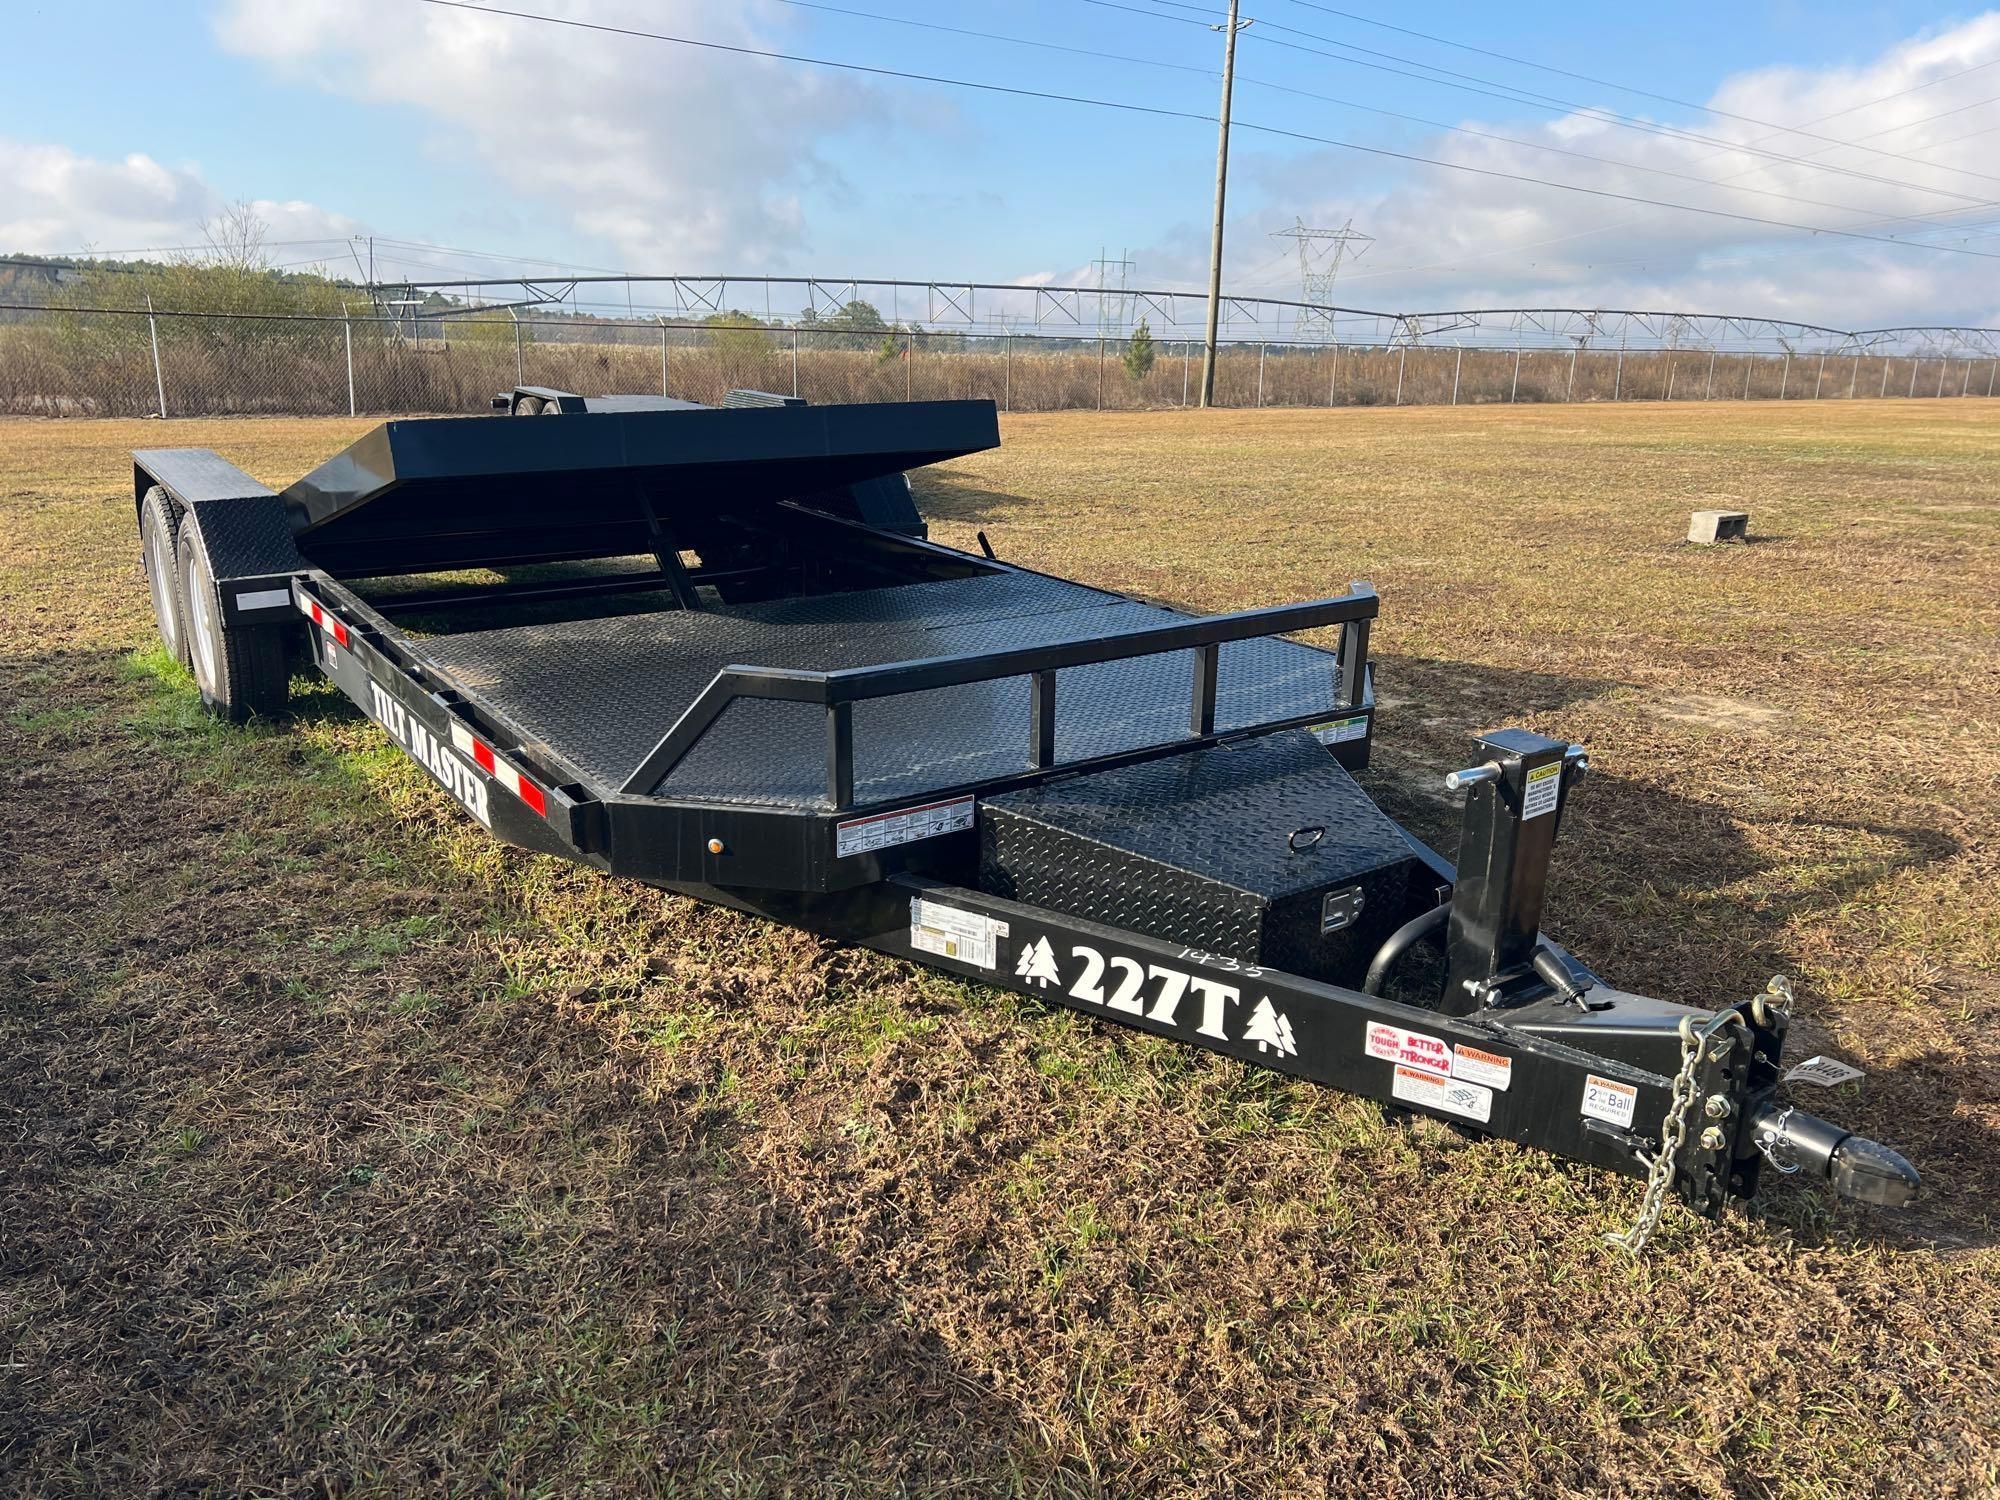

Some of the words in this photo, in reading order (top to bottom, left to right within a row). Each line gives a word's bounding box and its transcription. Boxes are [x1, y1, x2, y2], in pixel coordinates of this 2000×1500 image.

[370, 680, 407, 745] TILT
[408, 715, 492, 829] MASTER
[1536, 767, 1557, 778] CAUTION
[1177, 948, 1280, 978] 1435
[1068, 945, 1241, 1042] 227T
[1370, 1035, 1400, 1049] TOUGH
[1407, 1036, 1444, 1055] BETTER
[1400, 1049, 1450, 1072] STRONGER
[1467, 1050, 1510, 1067] WARNING
[1409, 1070, 1441, 1084] WARNING
[1600, 1081, 1631, 1094] WARNING
[1608, 1093, 1631, 1111] Ball
